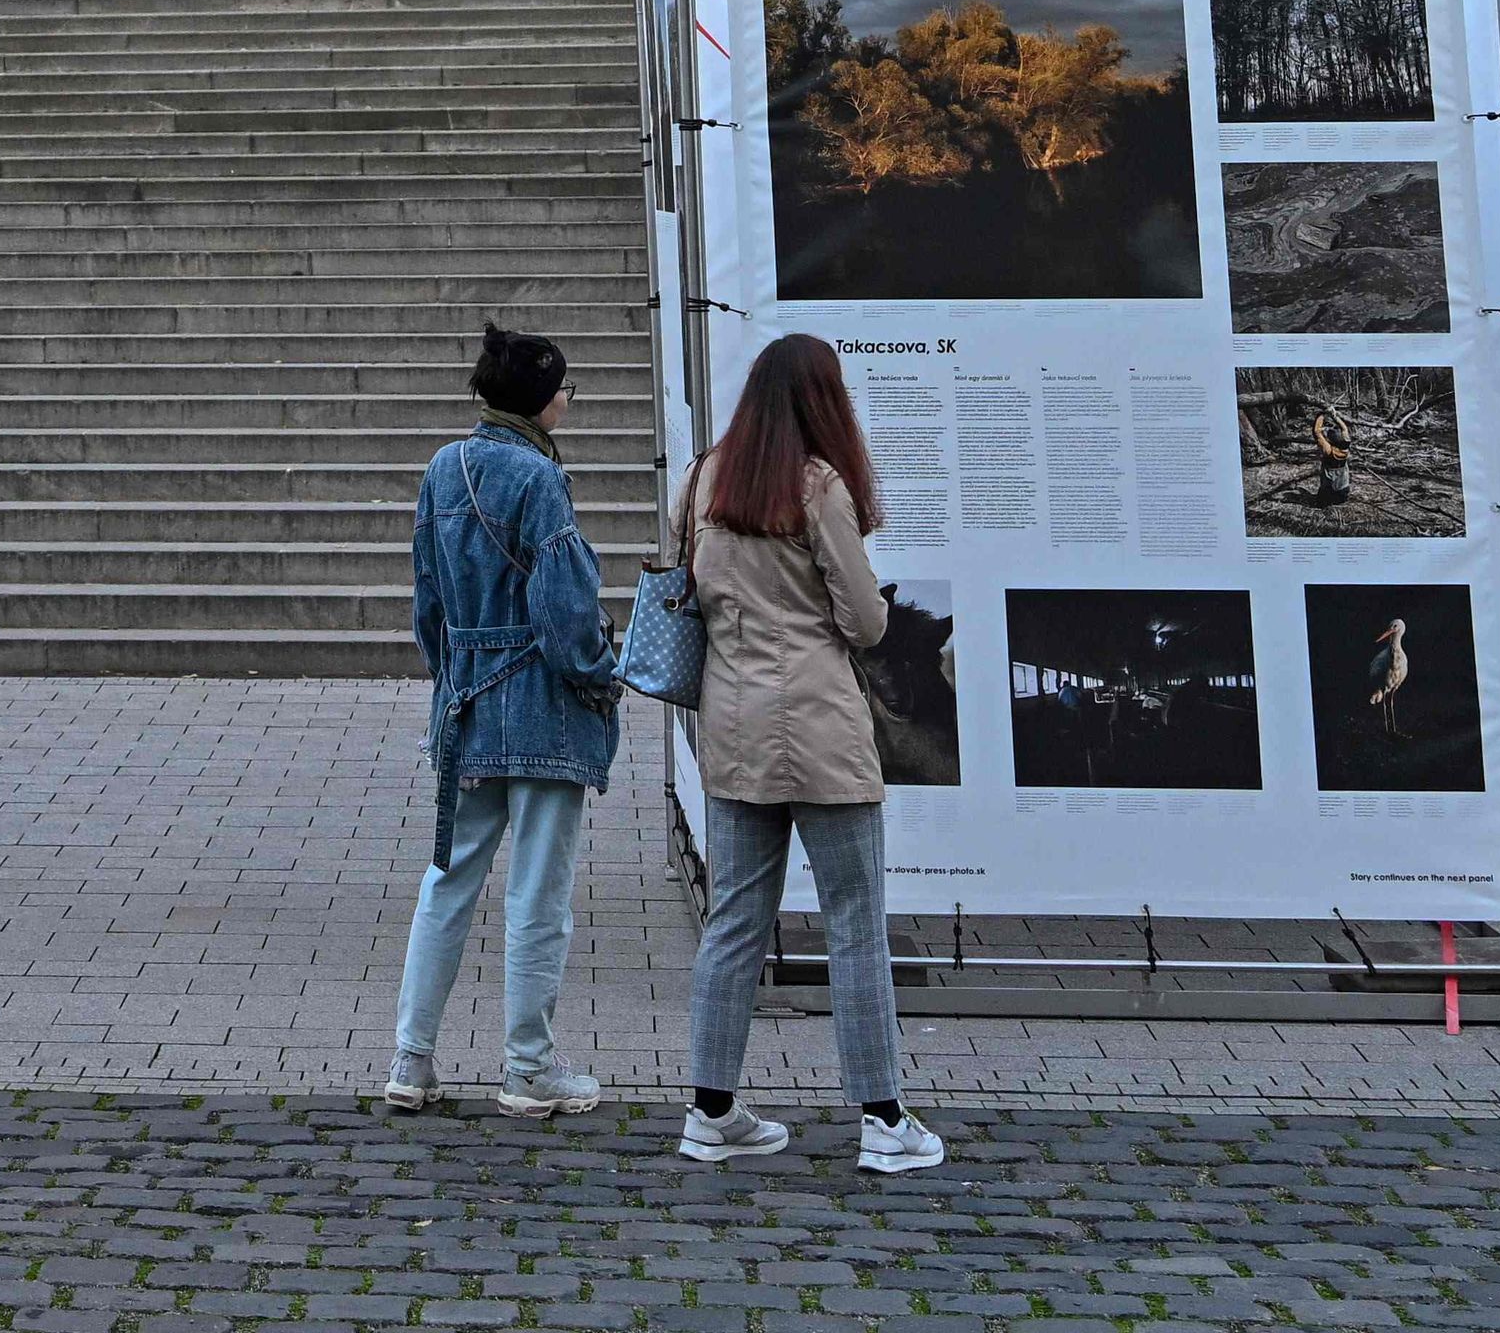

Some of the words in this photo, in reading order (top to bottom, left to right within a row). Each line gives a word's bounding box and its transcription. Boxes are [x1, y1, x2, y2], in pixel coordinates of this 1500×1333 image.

[835, 339, 930, 355] Takacsova,
[936, 338, 958, 354] SK
[1350, 872, 1372, 883] Story
[1373, 873, 1416, 883] continues
[1417, 874, 1429, 882] on
[1431, 874, 1445, 882] the
[1447, 874, 1466, 882] next
[1468, 874, 1494, 884] panel
